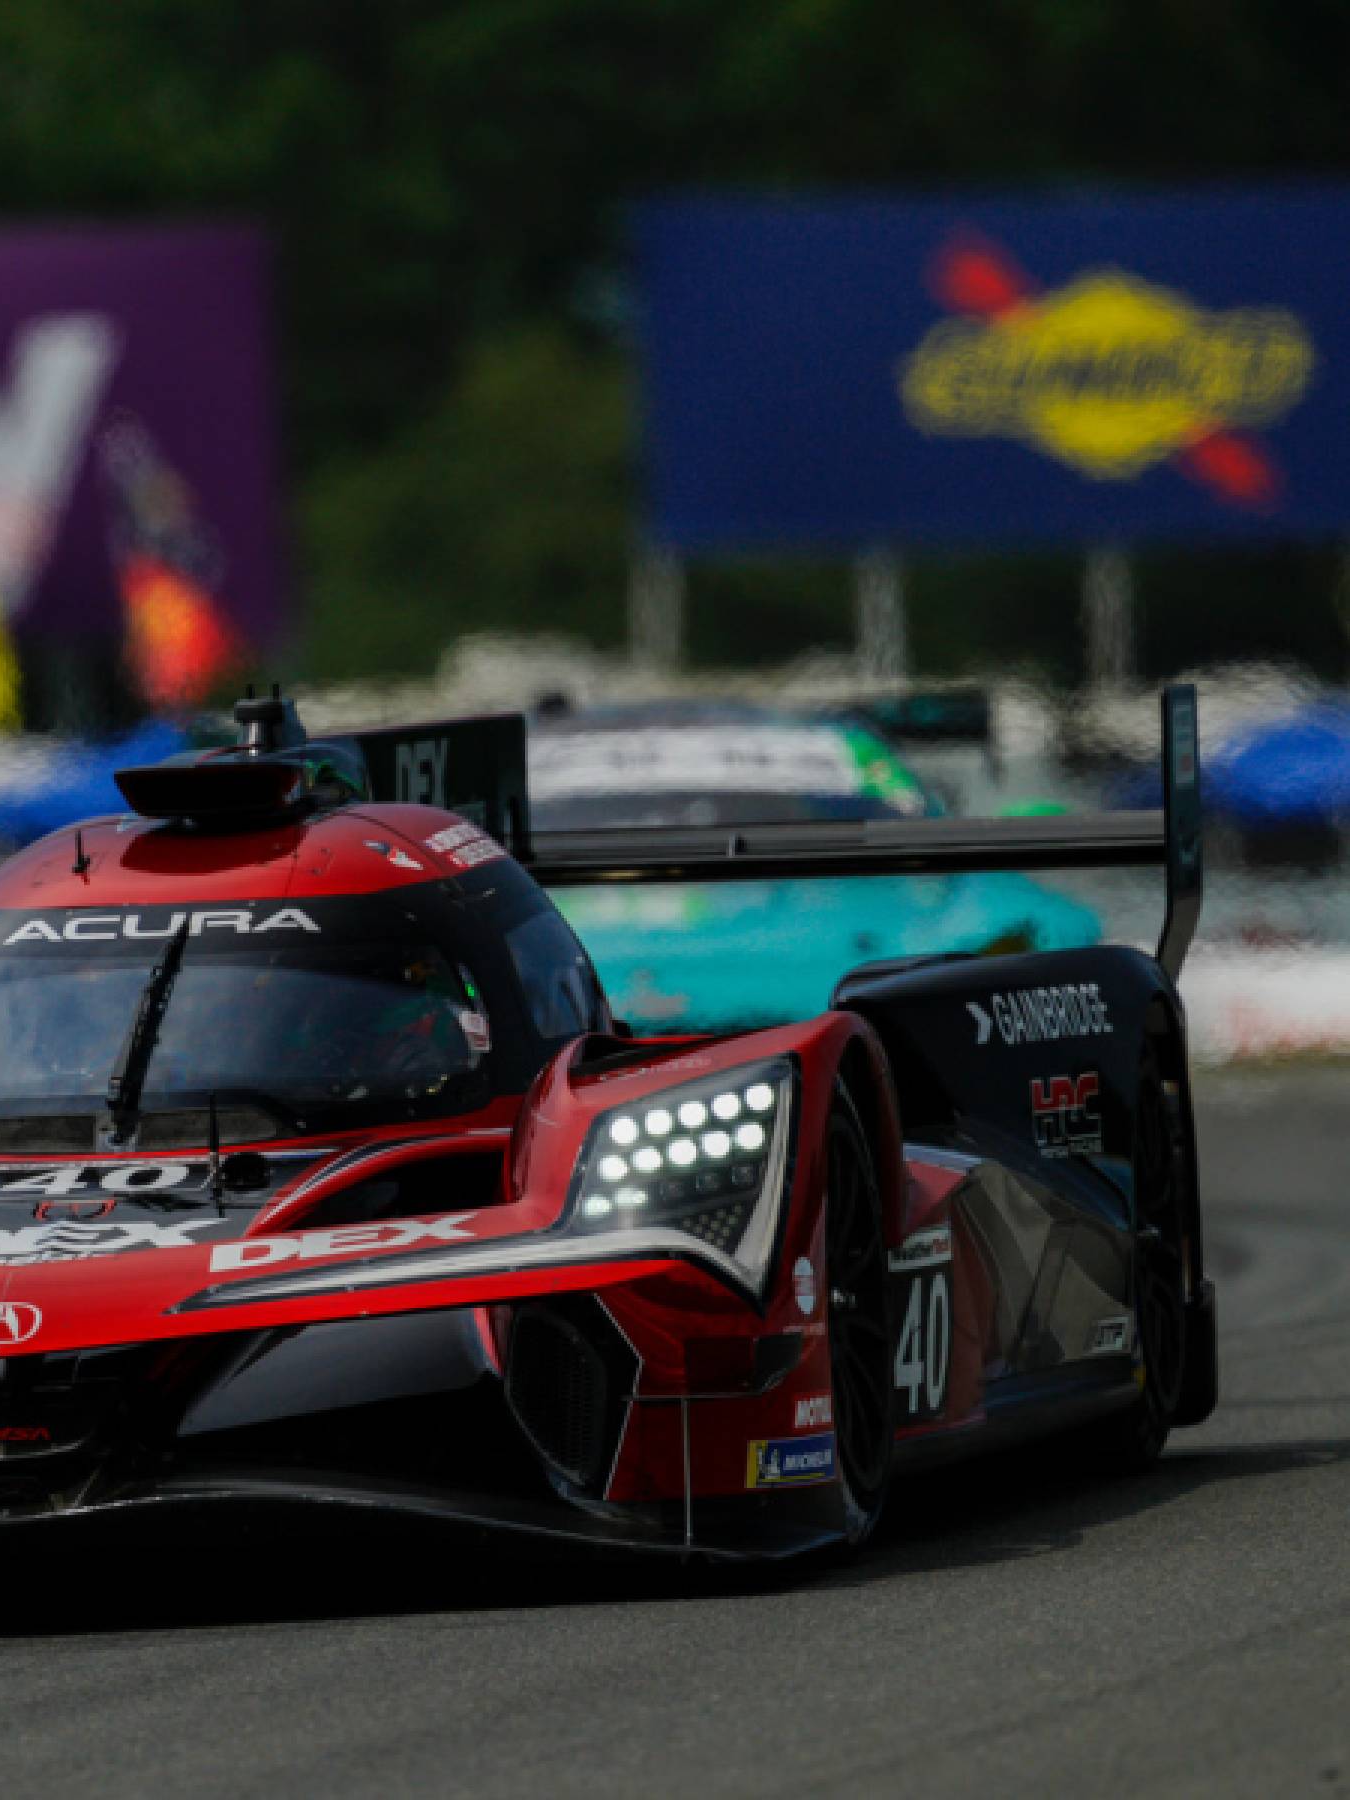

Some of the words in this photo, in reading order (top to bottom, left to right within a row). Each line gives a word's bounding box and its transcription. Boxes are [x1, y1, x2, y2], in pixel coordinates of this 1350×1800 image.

[2, 907, 322, 946] ACURA
[991, 983, 1115, 1046] GAINBRIDGE
[209, 1215, 481, 1273] DEX
[893, 1271, 951, 1415] 40
